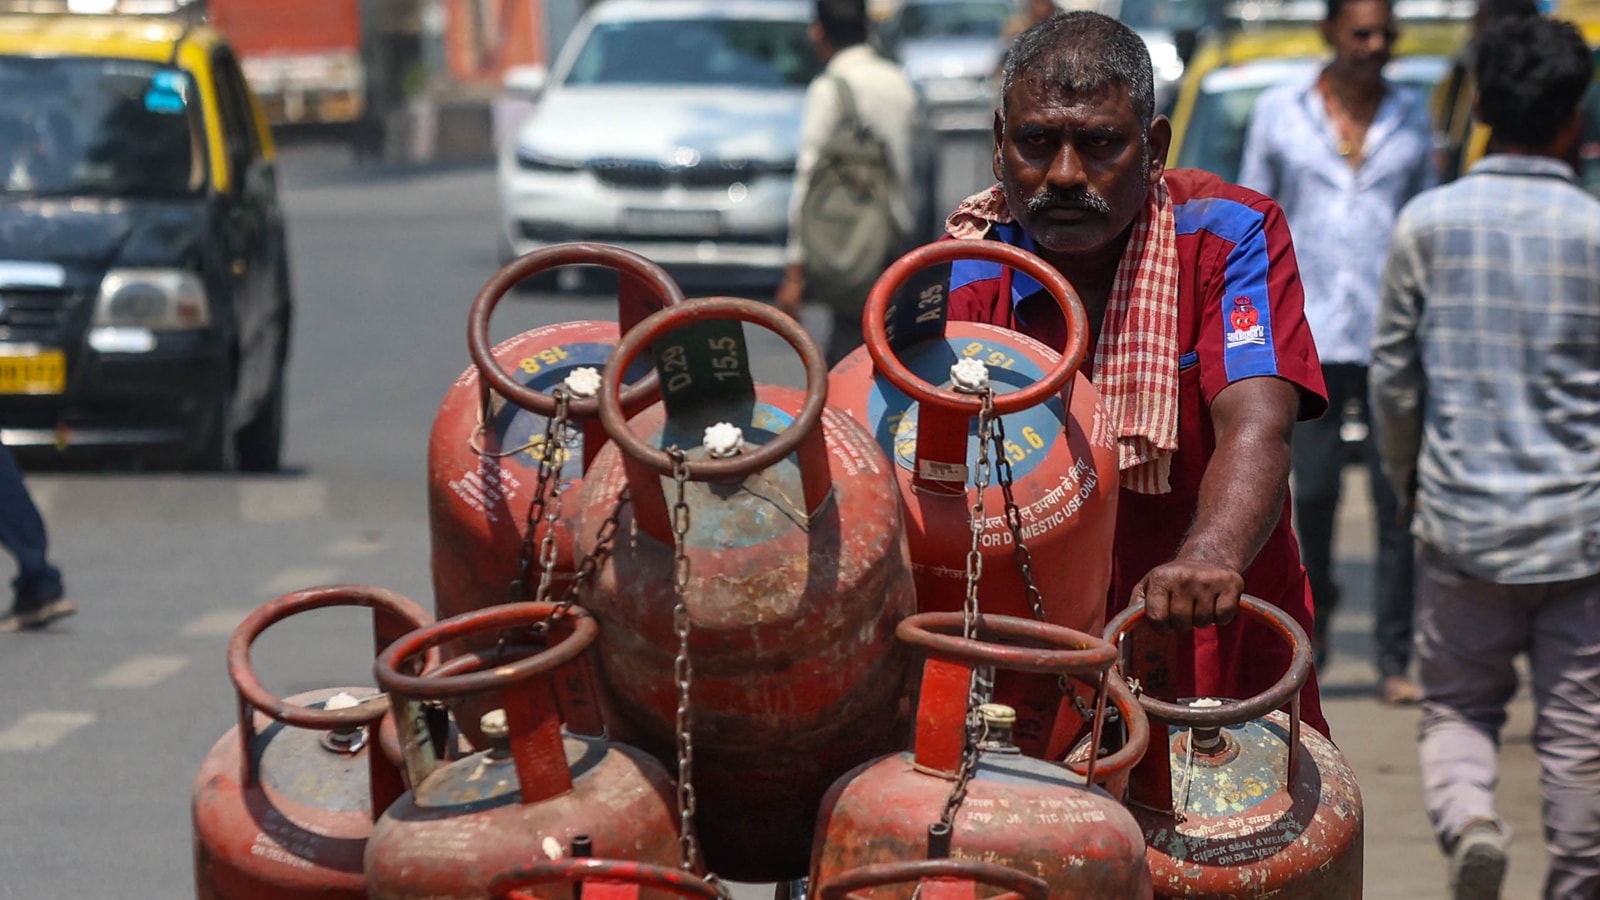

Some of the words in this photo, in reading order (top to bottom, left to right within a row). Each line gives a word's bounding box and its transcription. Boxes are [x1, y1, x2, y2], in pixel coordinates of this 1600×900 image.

[519, 346, 568, 374] 15.8
[661, 345, 692, 392] D.29
[708, 336, 740, 381] 15.5
[962, 342, 1015, 370] 15.6
[1031, 486, 1065, 512] उपयोग
[1059, 476, 1074, 491] के
[1068, 457, 1088, 483] लिए
[1003, 511, 1063, 544] DMESTIC
[1063, 494, 1083, 517] USE
[1080, 468, 1098, 499] ONLY
[1246, 813, 1271, 825] समय
[1219, 855, 1234, 865] ON
[1229, 840, 1253, 852] SEAL
